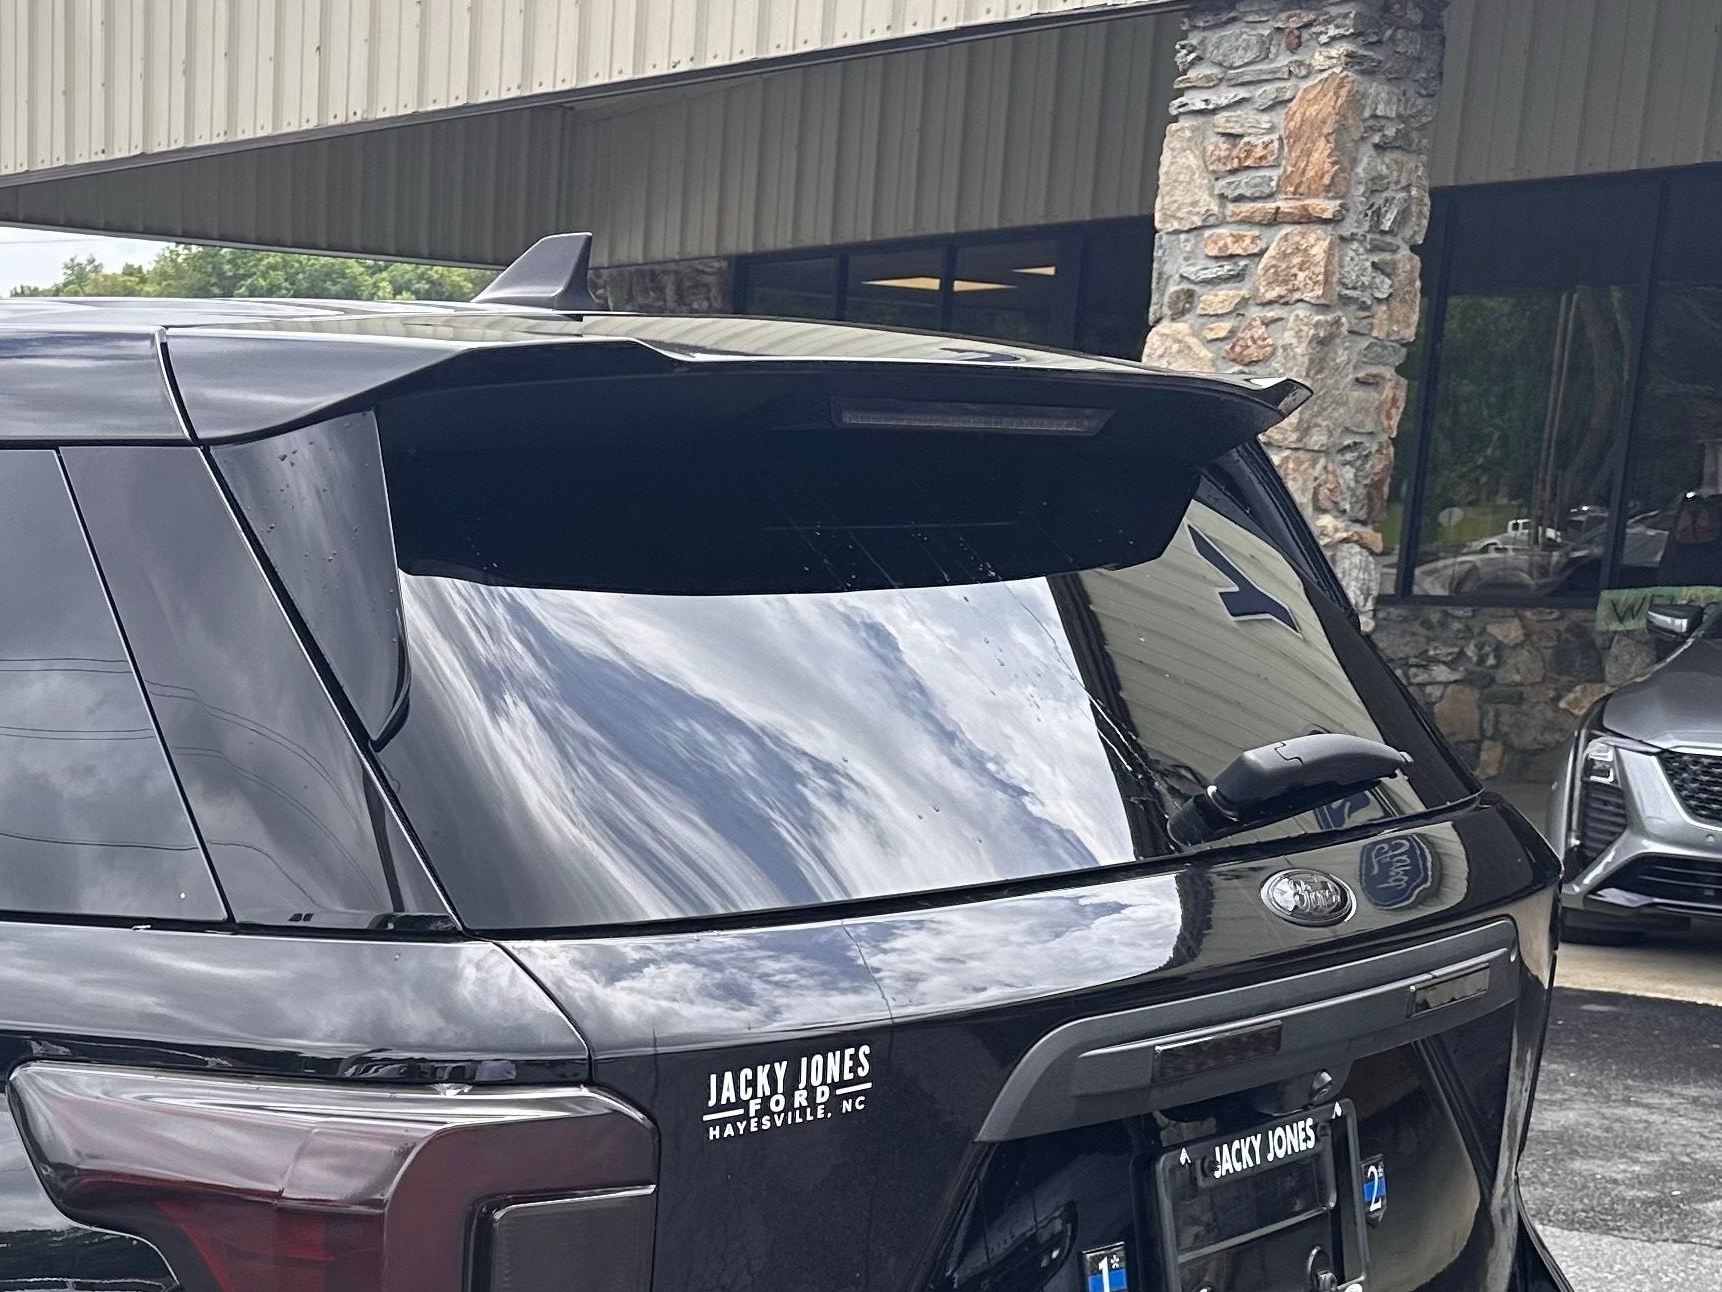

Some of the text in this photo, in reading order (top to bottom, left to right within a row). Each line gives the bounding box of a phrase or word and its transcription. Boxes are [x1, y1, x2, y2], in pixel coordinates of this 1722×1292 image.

[708, 1045, 871, 1107] JACKY JONES
[748, 1084, 831, 1118] FORD
[708, 1095, 867, 1141] HAYESVILLE, NC
[1213, 1117, 1316, 1179] JACKY JONES
